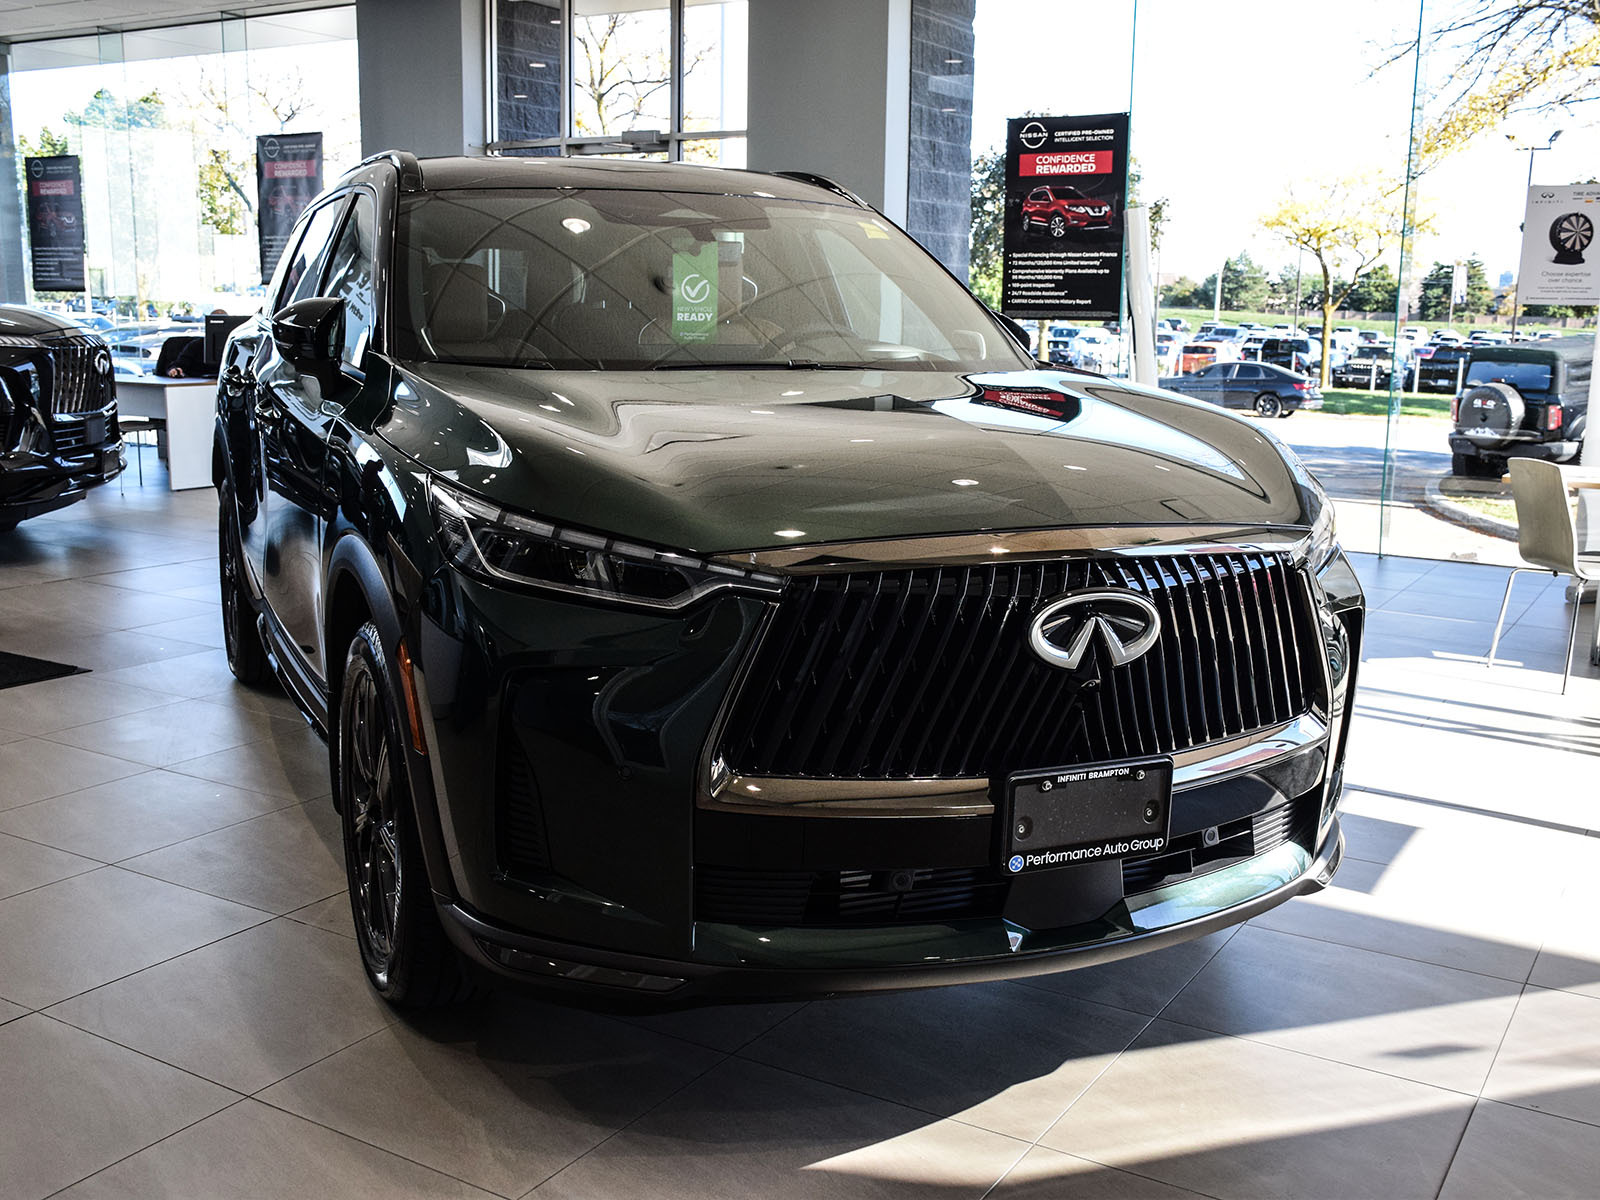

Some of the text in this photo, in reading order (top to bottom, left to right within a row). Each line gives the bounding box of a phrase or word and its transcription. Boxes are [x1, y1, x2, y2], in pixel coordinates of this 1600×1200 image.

[1036, 154, 1095, 165] CONFIDENCE
[1036, 163, 1096, 174] REWARDED
[676, 312, 713, 321] READY
[1057, 767, 1130, 783] INFINITI BRAMPTON
[1026, 837, 1164, 866] Performance Auto Group
